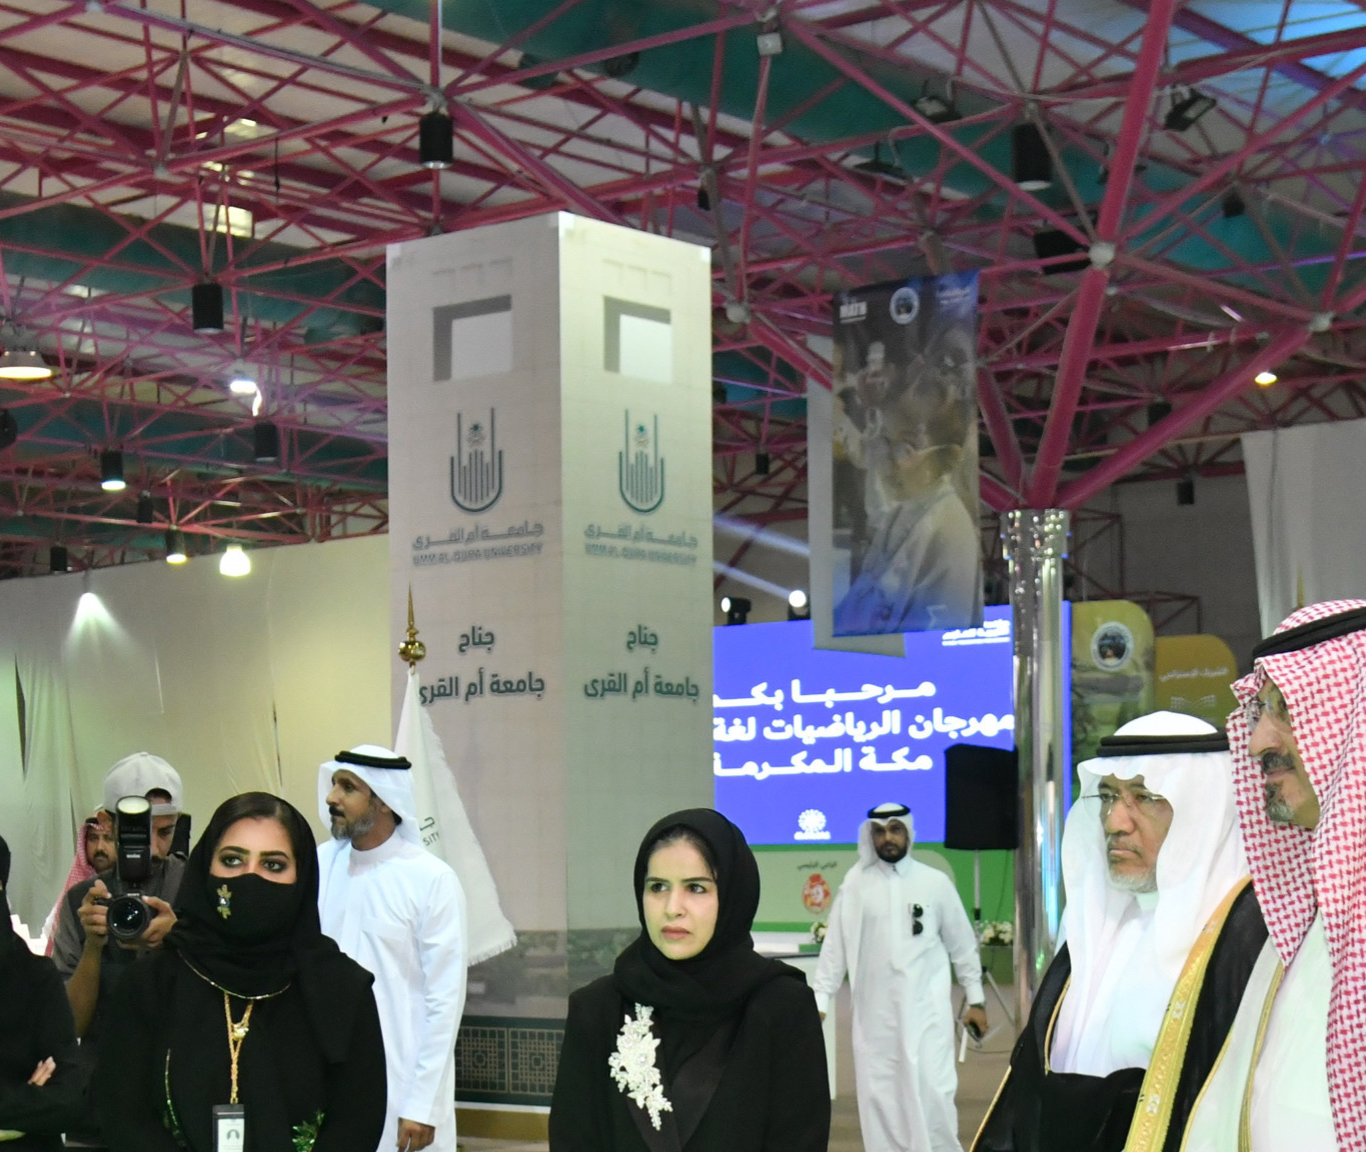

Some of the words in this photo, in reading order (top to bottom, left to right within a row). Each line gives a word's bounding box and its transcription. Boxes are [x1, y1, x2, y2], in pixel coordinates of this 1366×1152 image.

[458, 625, 495, 653] جناح
[626, 624, 659, 653] جناح
[464, 667, 484, 702] أم
[489, 671, 546, 698] جامعة
[584, 672, 628, 698] القرى
[632, 667, 649, 700] أم
[654, 675, 700, 703] جامعة
[713, 682, 784, 711] بك
[791, 679, 936, 708] مرحبا
[713, 716, 757, 742] لغة
[763, 709, 901, 745] الرياضيات
[858, 745, 934, 771] مكة
